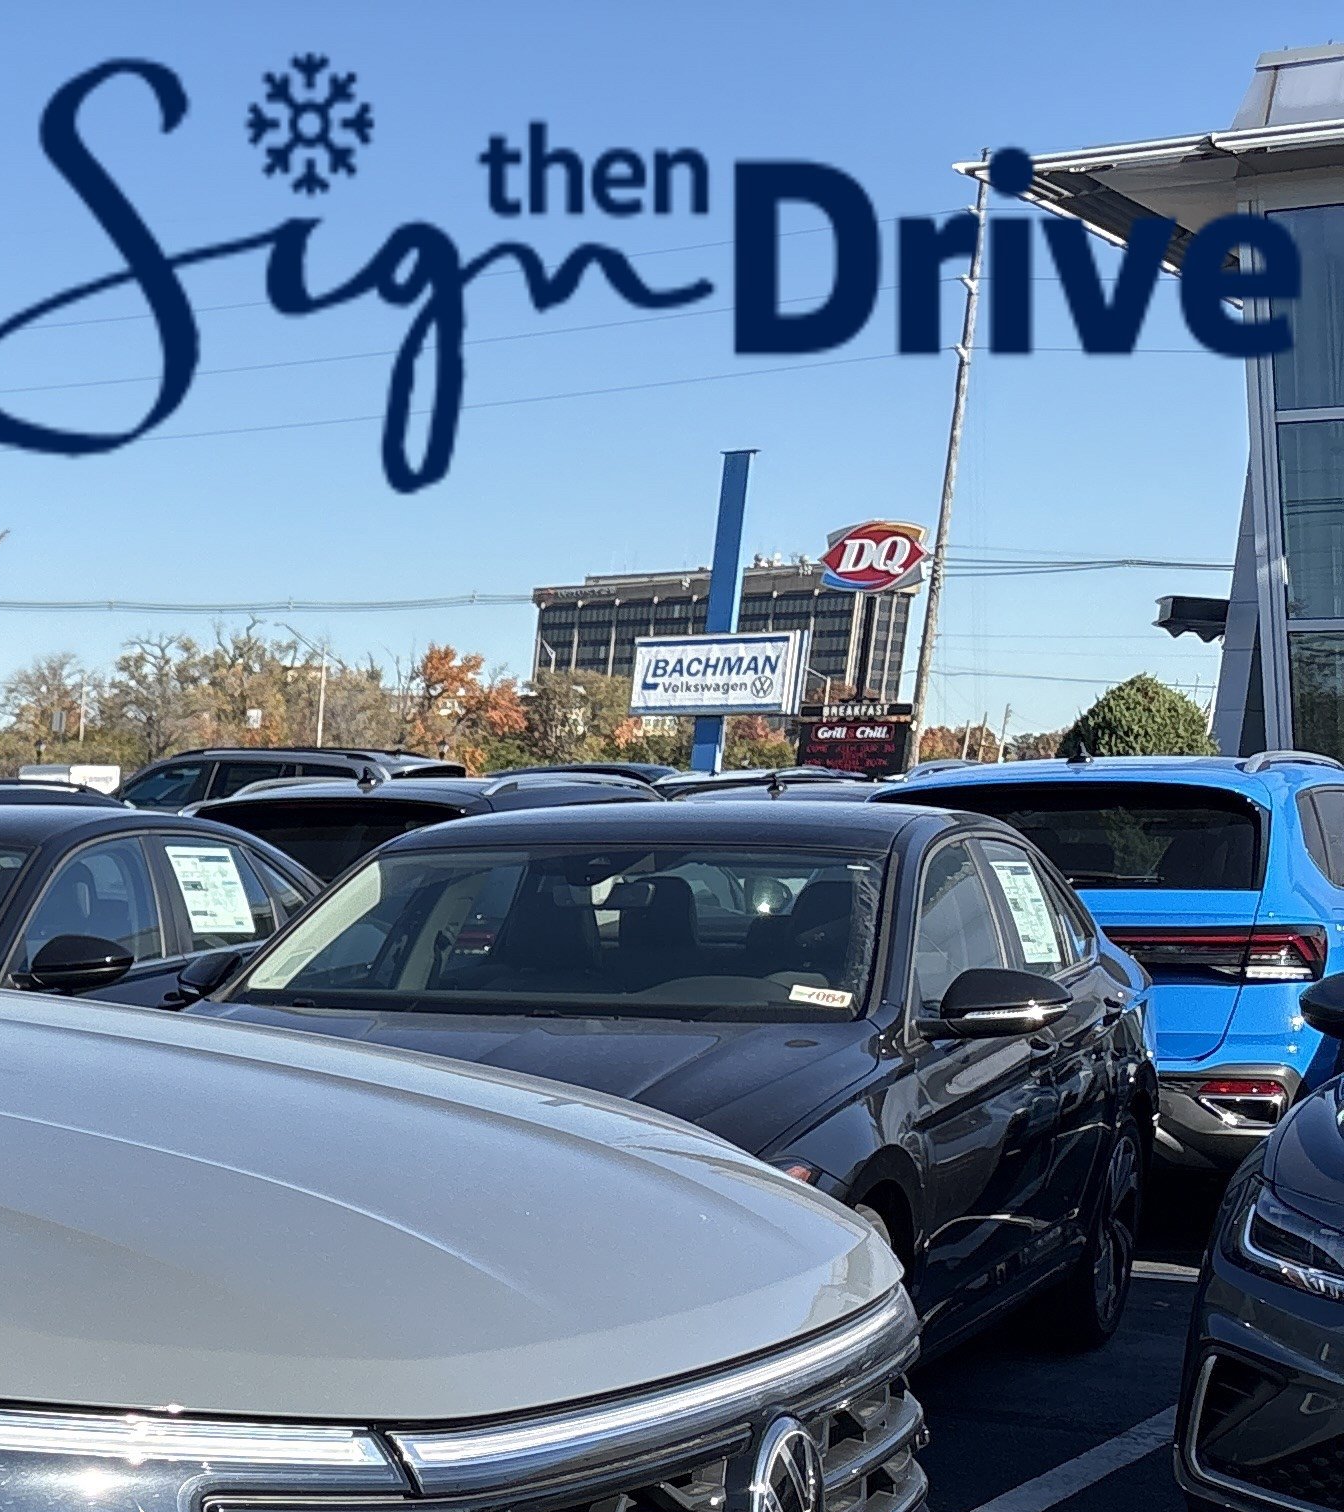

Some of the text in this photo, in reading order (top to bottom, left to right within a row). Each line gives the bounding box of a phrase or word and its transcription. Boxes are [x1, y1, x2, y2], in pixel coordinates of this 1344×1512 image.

[836, 536, 911, 575] DQ
[651, 654, 781, 679] BACHMAN
[662, 681, 748, 695] Volkswagen
[822, 704, 889, 717] BREAKFAST
[817, 726, 848, 740] Grill
